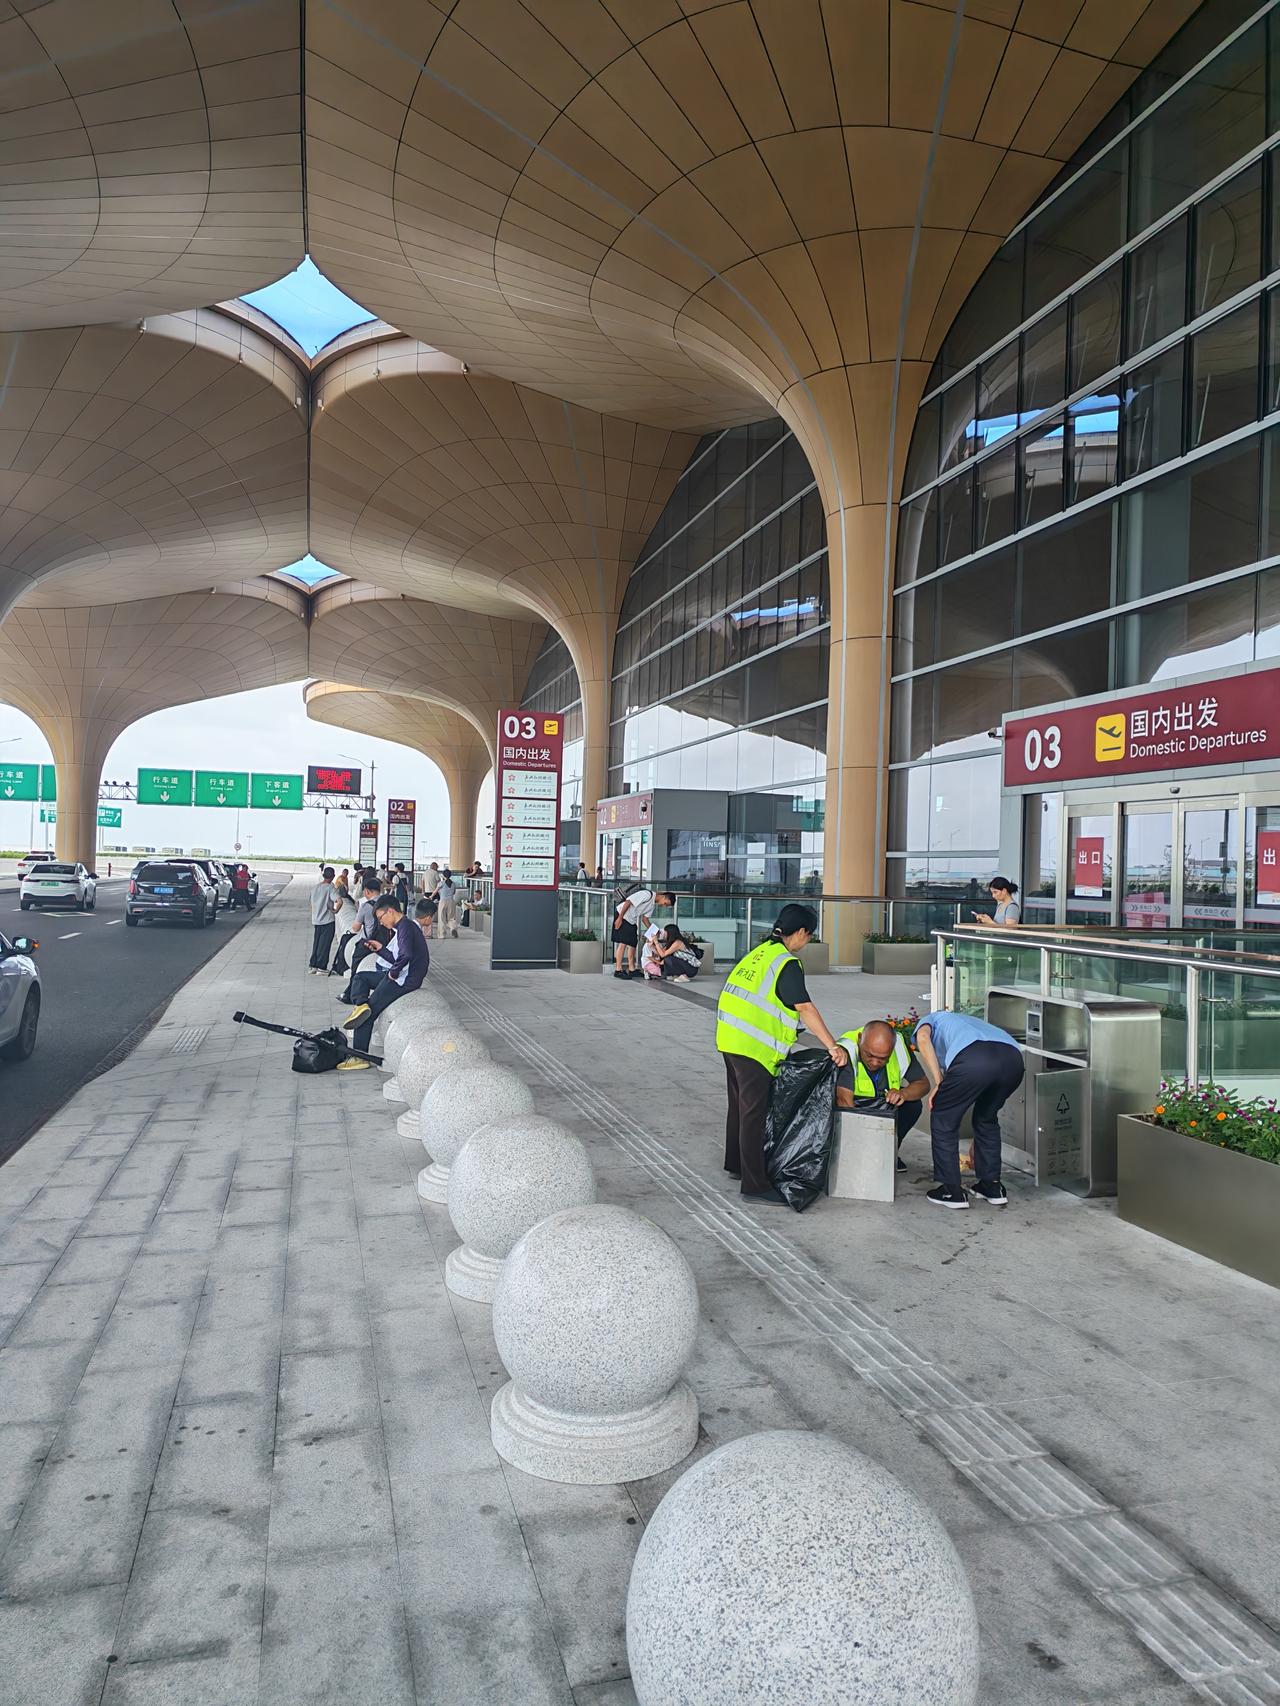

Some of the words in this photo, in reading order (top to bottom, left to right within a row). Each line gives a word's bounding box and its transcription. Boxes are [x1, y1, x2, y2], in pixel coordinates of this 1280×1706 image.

[1130, 697, 1218, 739] 国内出发
[504, 716, 536, 739] 03
[1024, 725, 1062, 771] 03
[1130, 739, 1185, 759] Domestic
[1189, 728, 1267, 752] Departures
[503, 746, 551, 761] 国内出发
[528, 761, 557, 769] Departures
[153, 776, 178, 785] 行车道
[209, 778, 234, 787] 行车道
[264, 781, 289, 789] 下客道
[390, 801, 404, 811] 02
[1078, 850, 1101, 864] 出口
[1263, 848, 1276, 865] 出
